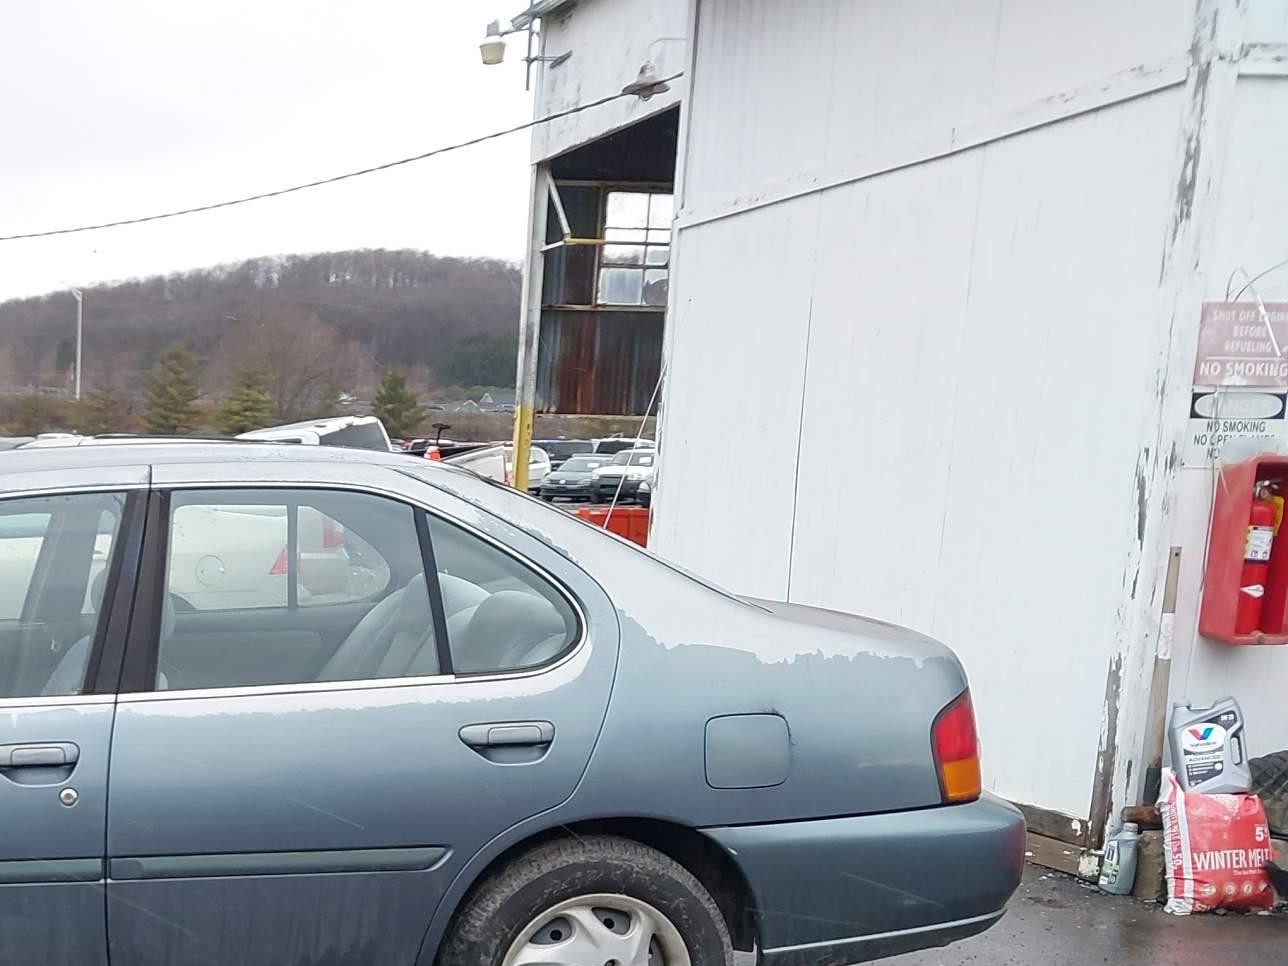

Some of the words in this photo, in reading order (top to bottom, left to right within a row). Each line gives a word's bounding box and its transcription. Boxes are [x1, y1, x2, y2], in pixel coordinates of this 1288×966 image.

[1213, 310, 1236, 321] SHUT
[1239, 310, 1256, 321] OFF
[1233, 325, 1267, 337] BEFORE
[1224, 340, 1272, 353] REFUELING
[1200, 361, 1221, 377] NO
[1225, 361, 1288, 377] SMOKING
[1206, 421, 1220, 433] NO
[1223, 421, 1266, 433] SMOKING
[1193, 434, 1207, 446] NO
[1193, 849, 1248, 872] WINTER
